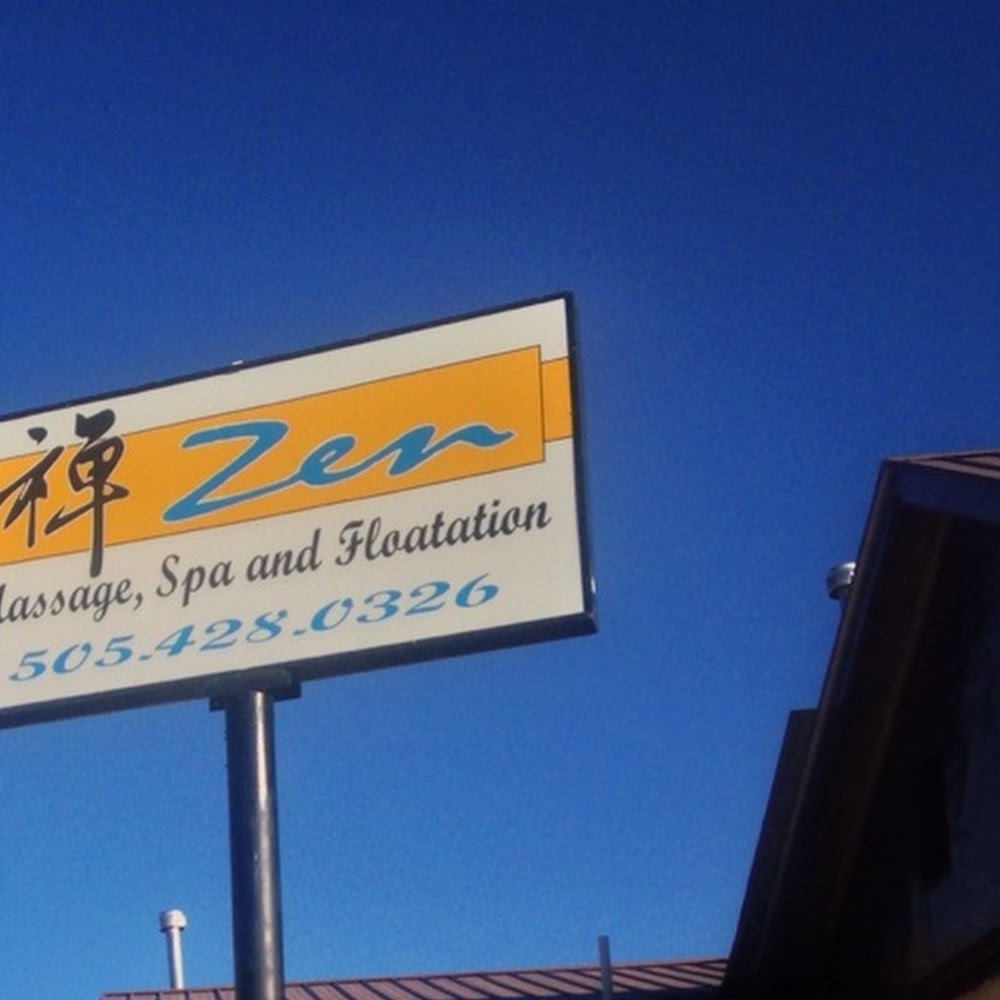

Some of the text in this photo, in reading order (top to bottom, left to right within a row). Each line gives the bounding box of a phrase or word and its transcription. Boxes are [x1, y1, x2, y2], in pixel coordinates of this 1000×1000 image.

[161, 419, 515, 522] Zen
[156, 553, 235, 607] Spa
[246, 527, 322, 582] and
[335, 498, 552, 567] Floatation
[9, 572, 500, 682] 505.428.0326
